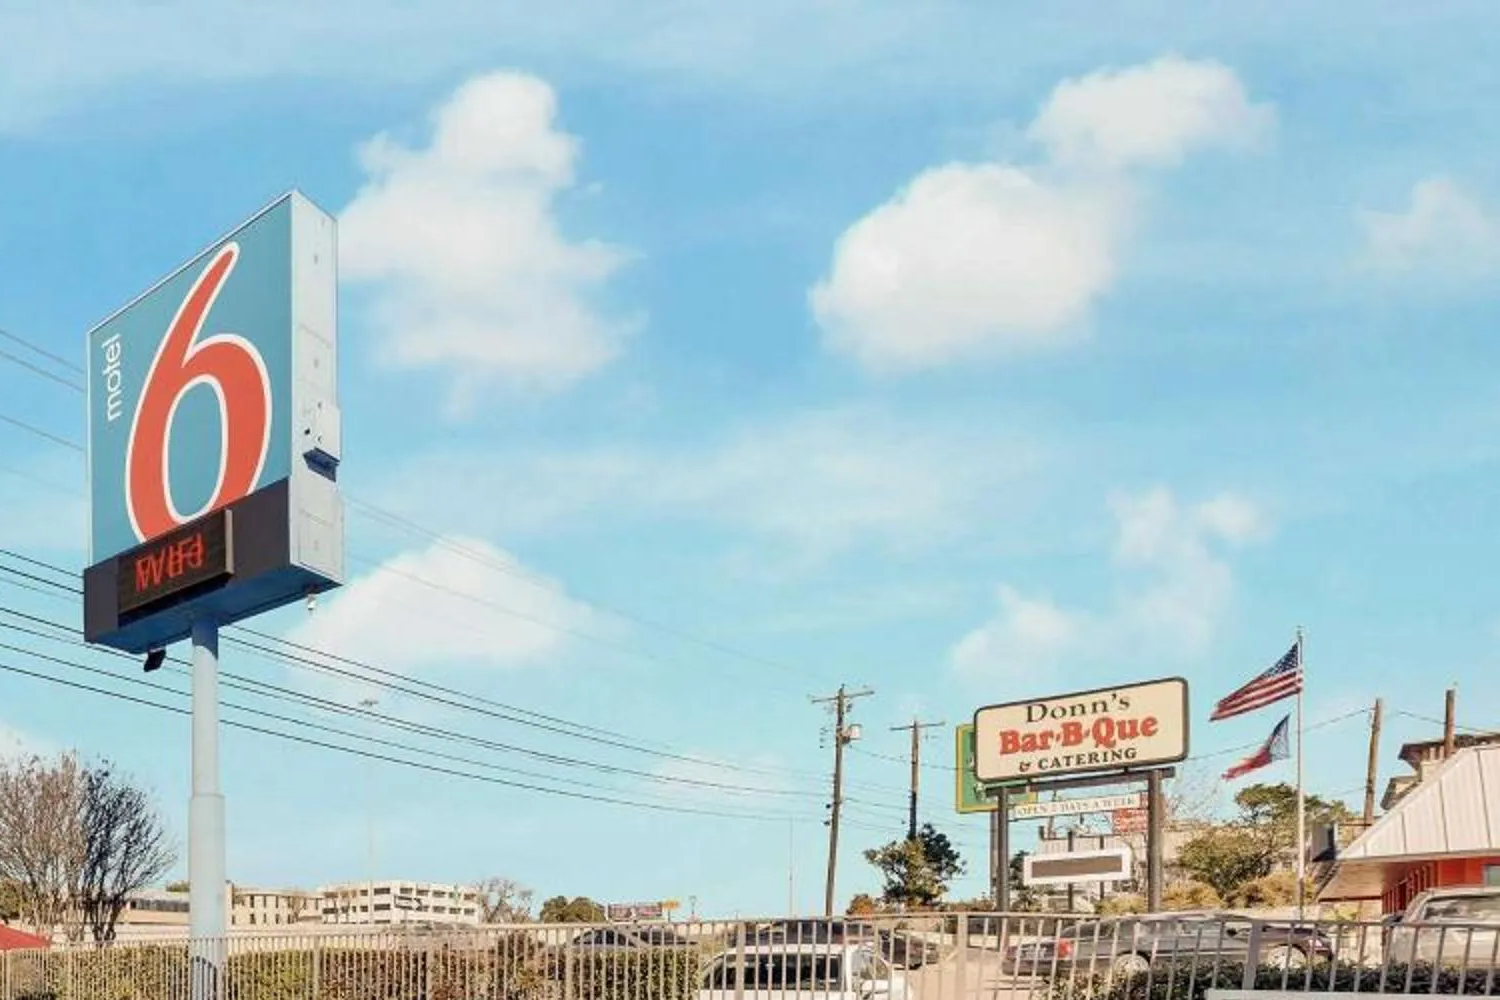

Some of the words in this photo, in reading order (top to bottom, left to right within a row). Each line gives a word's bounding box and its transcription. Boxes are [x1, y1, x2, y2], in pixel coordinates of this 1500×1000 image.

[101, 333, 122, 421] motel
[125, 241, 273, 543] 6
[1026, 694, 1130, 723] Donn's
[1037, 747, 1138, 771] CATERING
